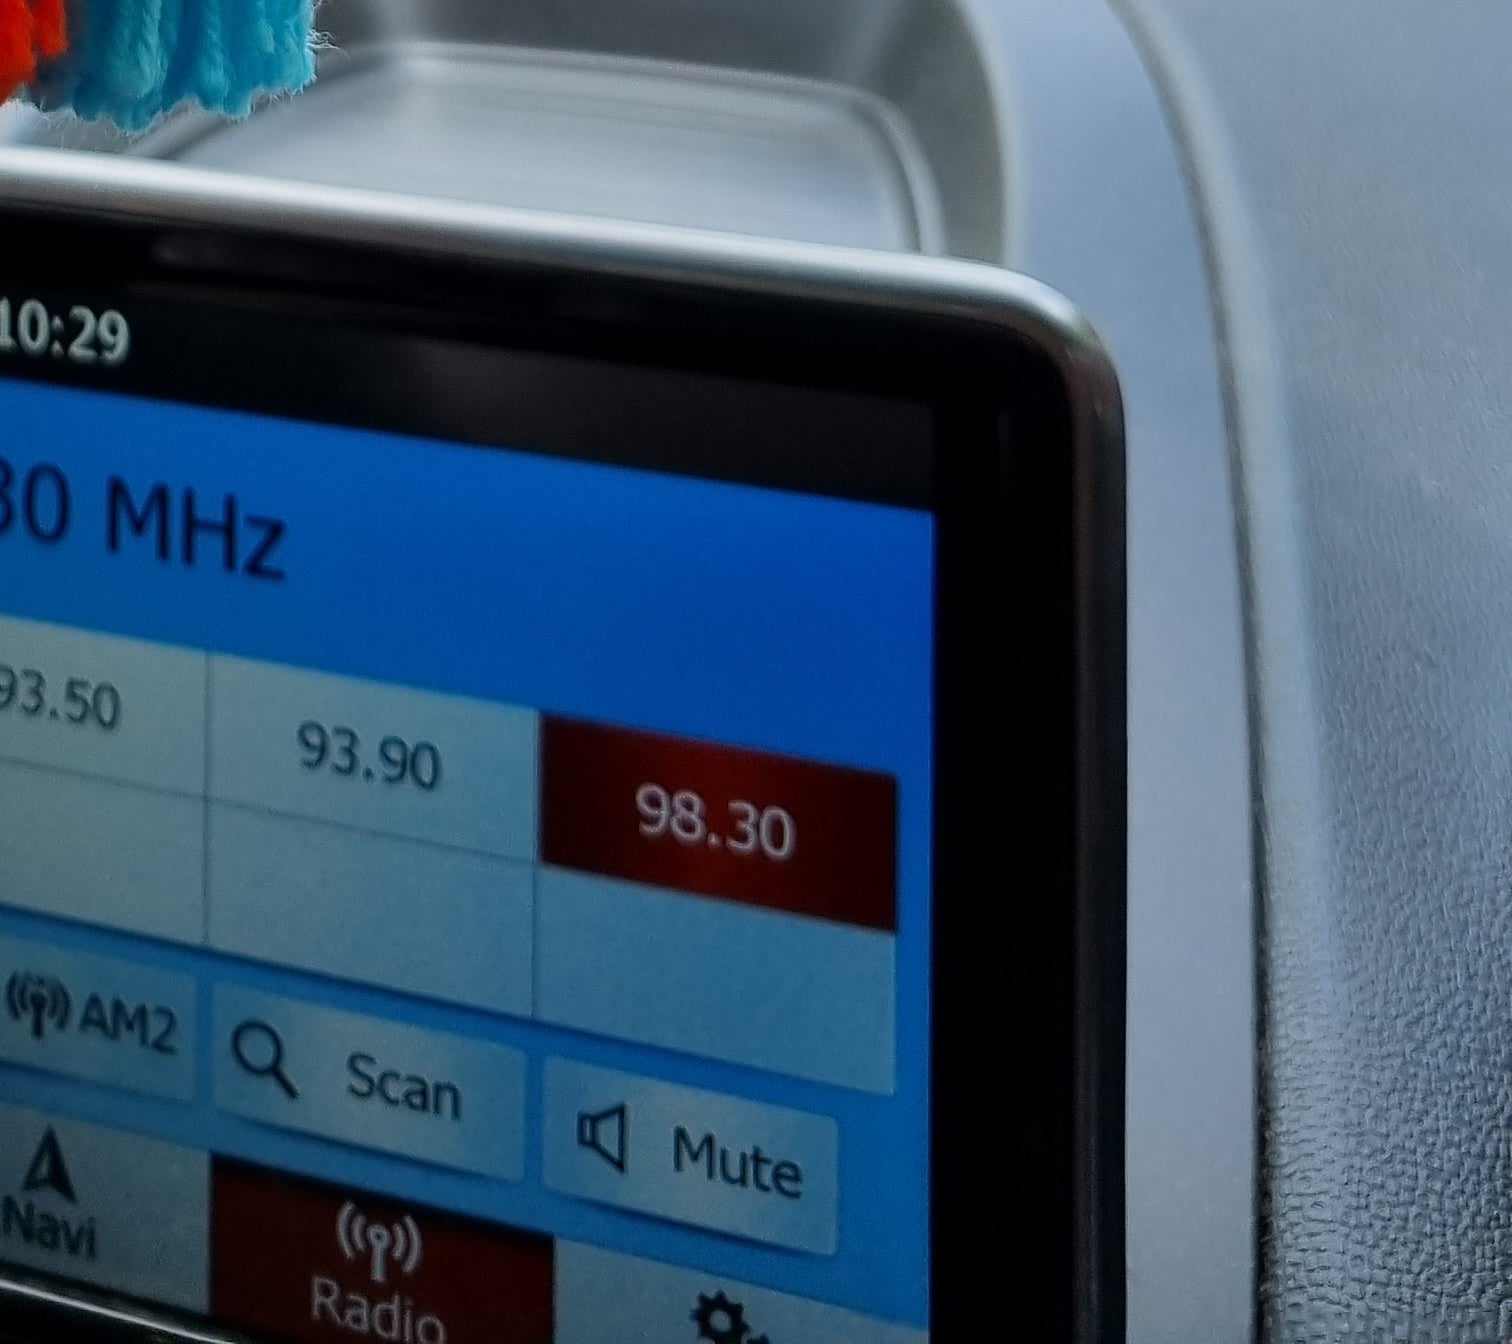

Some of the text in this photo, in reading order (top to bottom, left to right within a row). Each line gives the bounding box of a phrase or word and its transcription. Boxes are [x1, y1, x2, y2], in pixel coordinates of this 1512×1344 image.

[106, 475, 286, 582] MHz
[296, 720, 444, 792] 93.90
[635, 781, 798, 862] 98.30
[79, 992, 180, 1056] AM2
[345, 1051, 463, 1121] Scan
[672, 1125, 804, 1200] Mute
[1, 1194, 97, 1259] Navi
[309, 1275, 447, 1344] Radio
